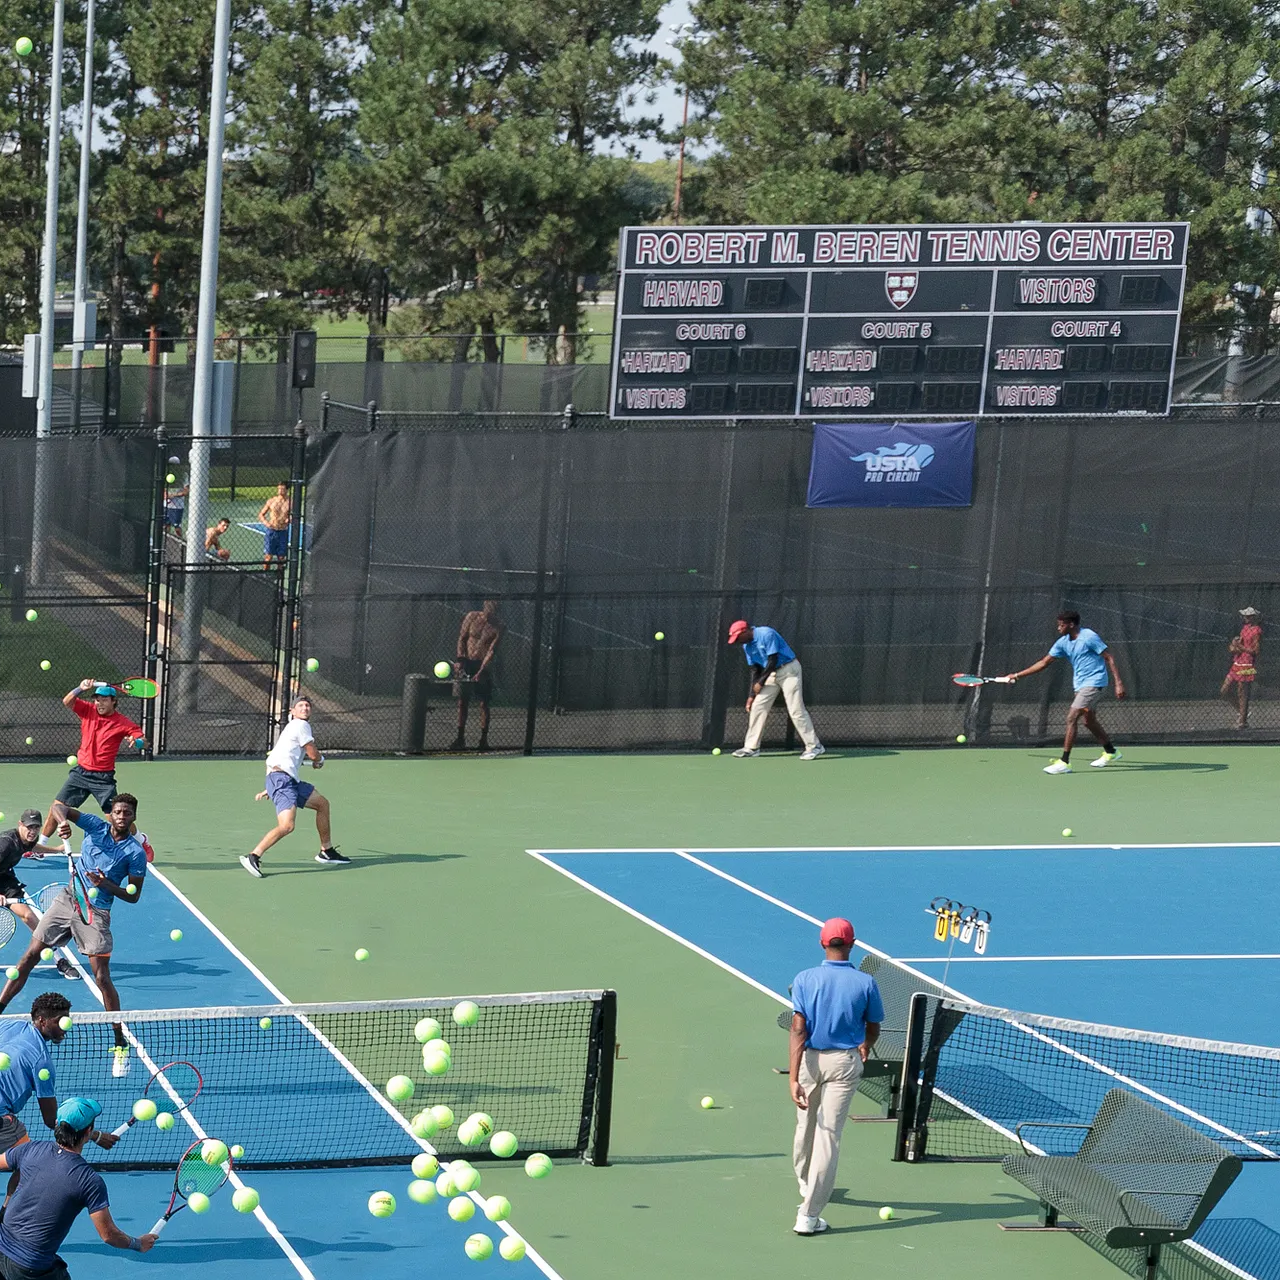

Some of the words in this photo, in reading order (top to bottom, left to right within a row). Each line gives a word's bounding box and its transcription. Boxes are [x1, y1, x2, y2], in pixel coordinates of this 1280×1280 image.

[635, 232, 767, 265] ROBERT
[770, 232, 806, 264] M.
[812, 231, 921, 264] BEREN
[927, 229, 1041, 263] TENNIS
[1047, 229, 1175, 261] CENTER
[642, 279, 724, 308] HARVARD
[1019, 277, 1096, 305] VISITORS
[675, 323, 734, 340] COURT
[735, 324, 746, 340] 6
[860, 322, 918, 339] COURT
[920, 322, 932, 338] 5
[1050, 321, 1107, 337] COURT
[1109, 321, 1121, 337] 4
[623, 351, 687, 373] HARVARD
[808, 350, 873, 372] HARVARD
[996, 349, 1061, 371] HARVARD
[625, 388, 687, 408] VISITORS
[809, 386, 871, 407] VISITORS
[996, 385, 1058, 407] VISITORS
[865, 456, 921, 472] USTA
[864, 472, 884, 483] PRO
[886, 471, 921, 483] CIRCUIT
